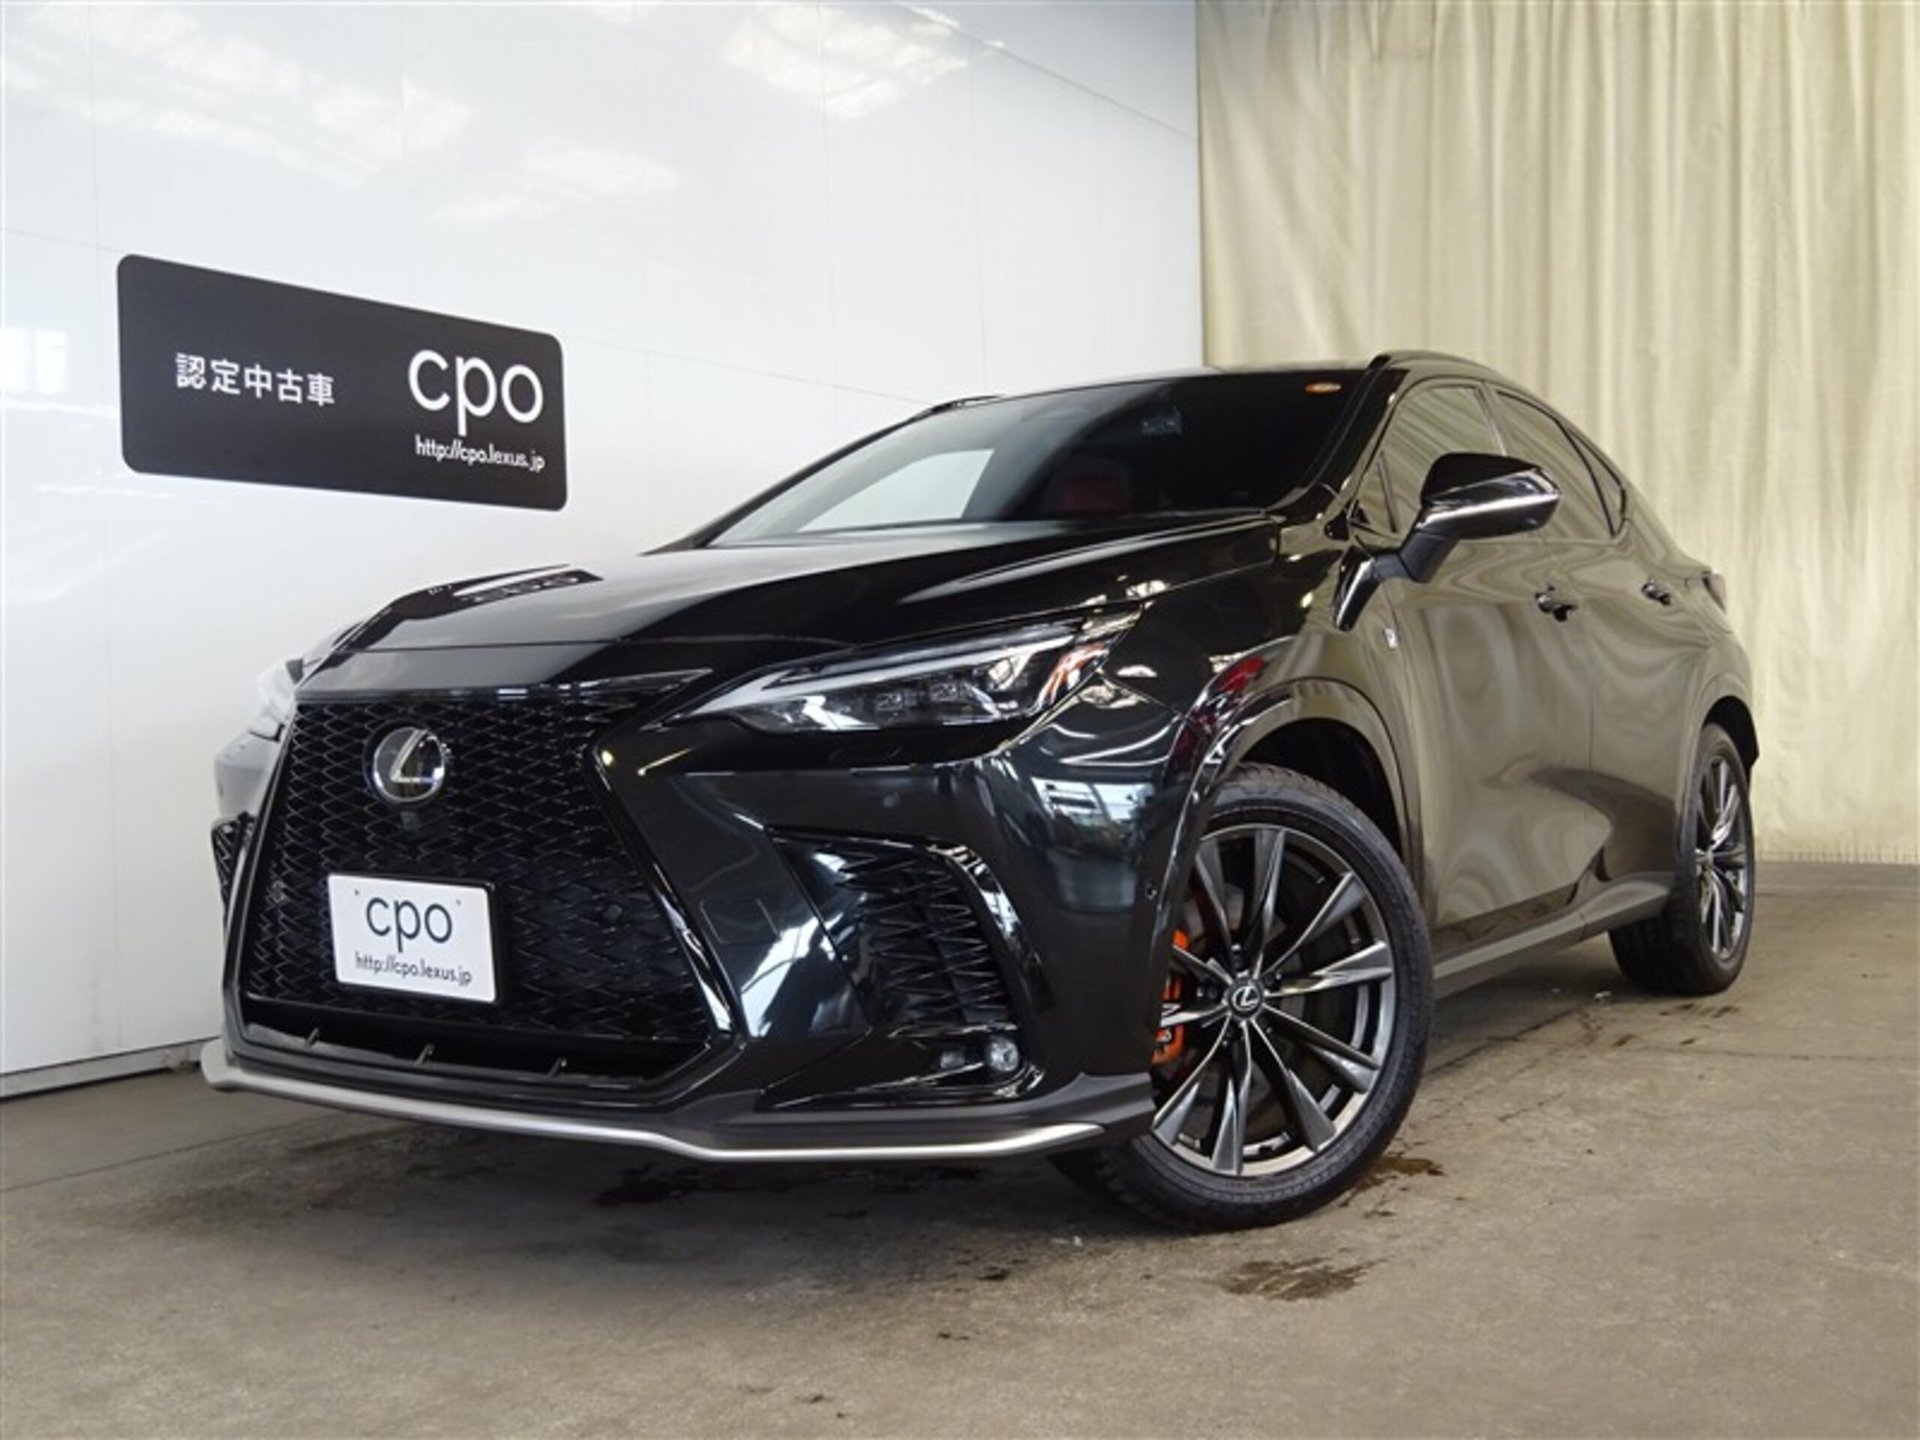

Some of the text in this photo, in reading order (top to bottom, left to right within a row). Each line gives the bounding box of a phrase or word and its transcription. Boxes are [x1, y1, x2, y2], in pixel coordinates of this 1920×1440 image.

[174, 352, 335, 407] 認定中古車
[408, 349, 544, 436] cpo
[415, 434, 546, 473] http://cpo.lexus.jp
[366, 897, 453, 954] cpo
[354, 952, 472, 987] http://cpo.lexus.jp
